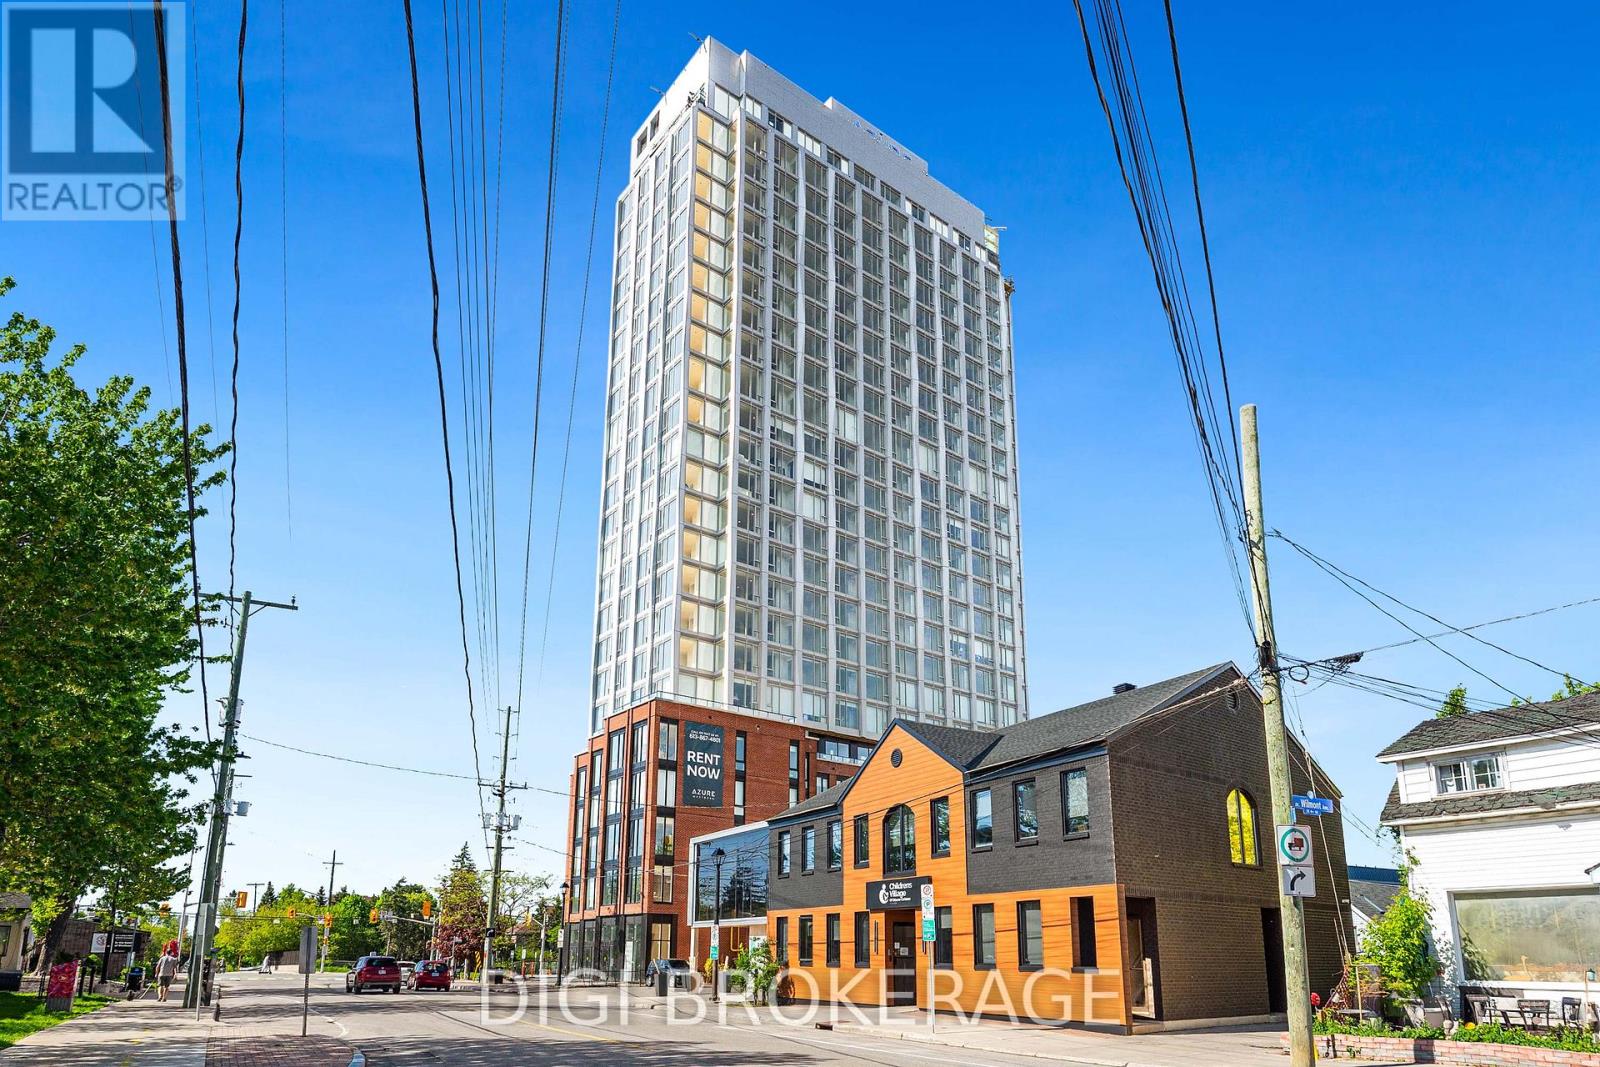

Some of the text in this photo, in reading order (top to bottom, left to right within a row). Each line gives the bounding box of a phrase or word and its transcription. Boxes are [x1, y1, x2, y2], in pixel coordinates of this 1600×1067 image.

[687, 751, 721, 766] RENT
[686, 765, 721, 780] NOW
[692, 788, 716, 798] AZURE
[889, 889, 906, 898] Village
